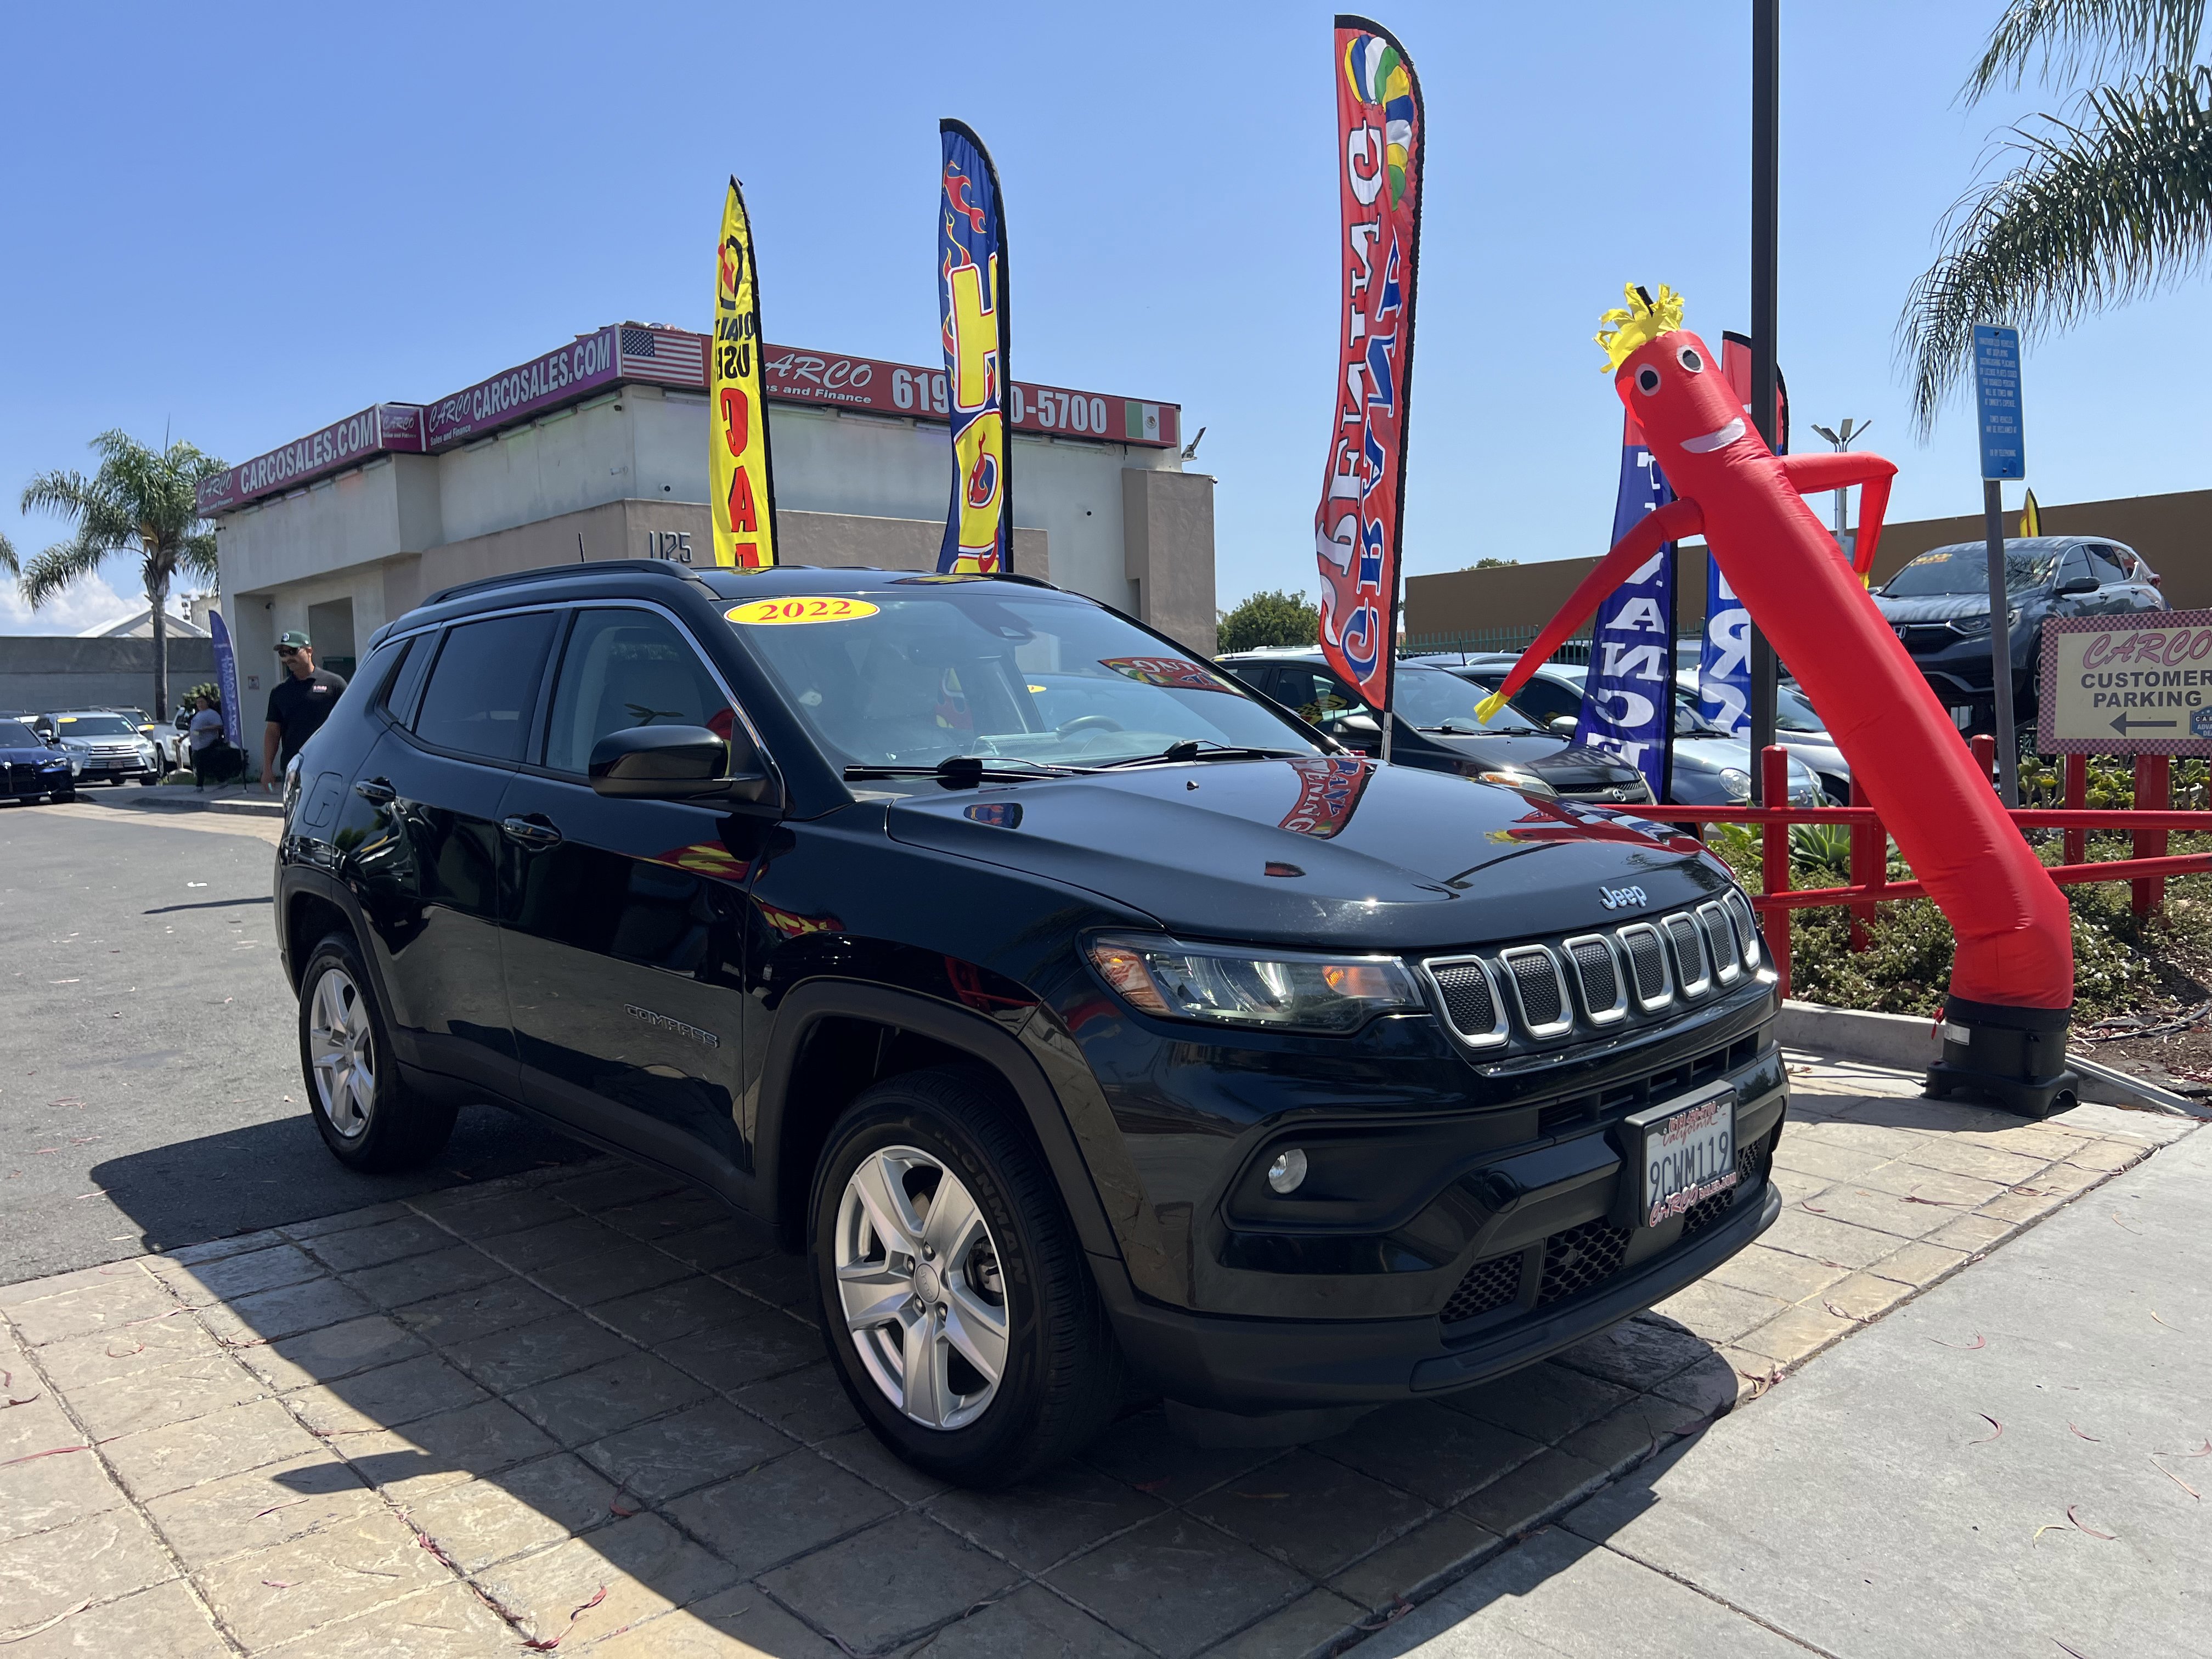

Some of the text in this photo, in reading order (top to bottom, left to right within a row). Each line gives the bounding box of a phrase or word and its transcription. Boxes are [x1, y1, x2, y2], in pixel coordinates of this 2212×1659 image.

[473, 332, 611, 421] CARCOSALES.COM
[765, 353, 873, 390] ARCO
[783, 386, 810, 396] and
[815, 389, 872, 404] Finance
[892, 368, 950, 414] 619
[429, 392, 471, 433] CARCO
[240, 411, 374, 494] CARCOSALES.COM
[198, 472, 233, 504] CARCO
[650, 531, 693, 563] 1125
[758, 601, 851, 620] 2022
[2083, 629, 2212, 669] CARCO
[2081, 670, 2212, 689] CUSTOMER
[2093, 691, 2202, 708] PARKING
[1598, 885, 1647, 910] Jeep
[624, 1004, 720, 1048] COMPASS
[1663, 1114, 1719, 1147] California
[1650, 1131, 1729, 1207] 9CWM119
[1699, 1172, 1737, 1200] SALES.COM
